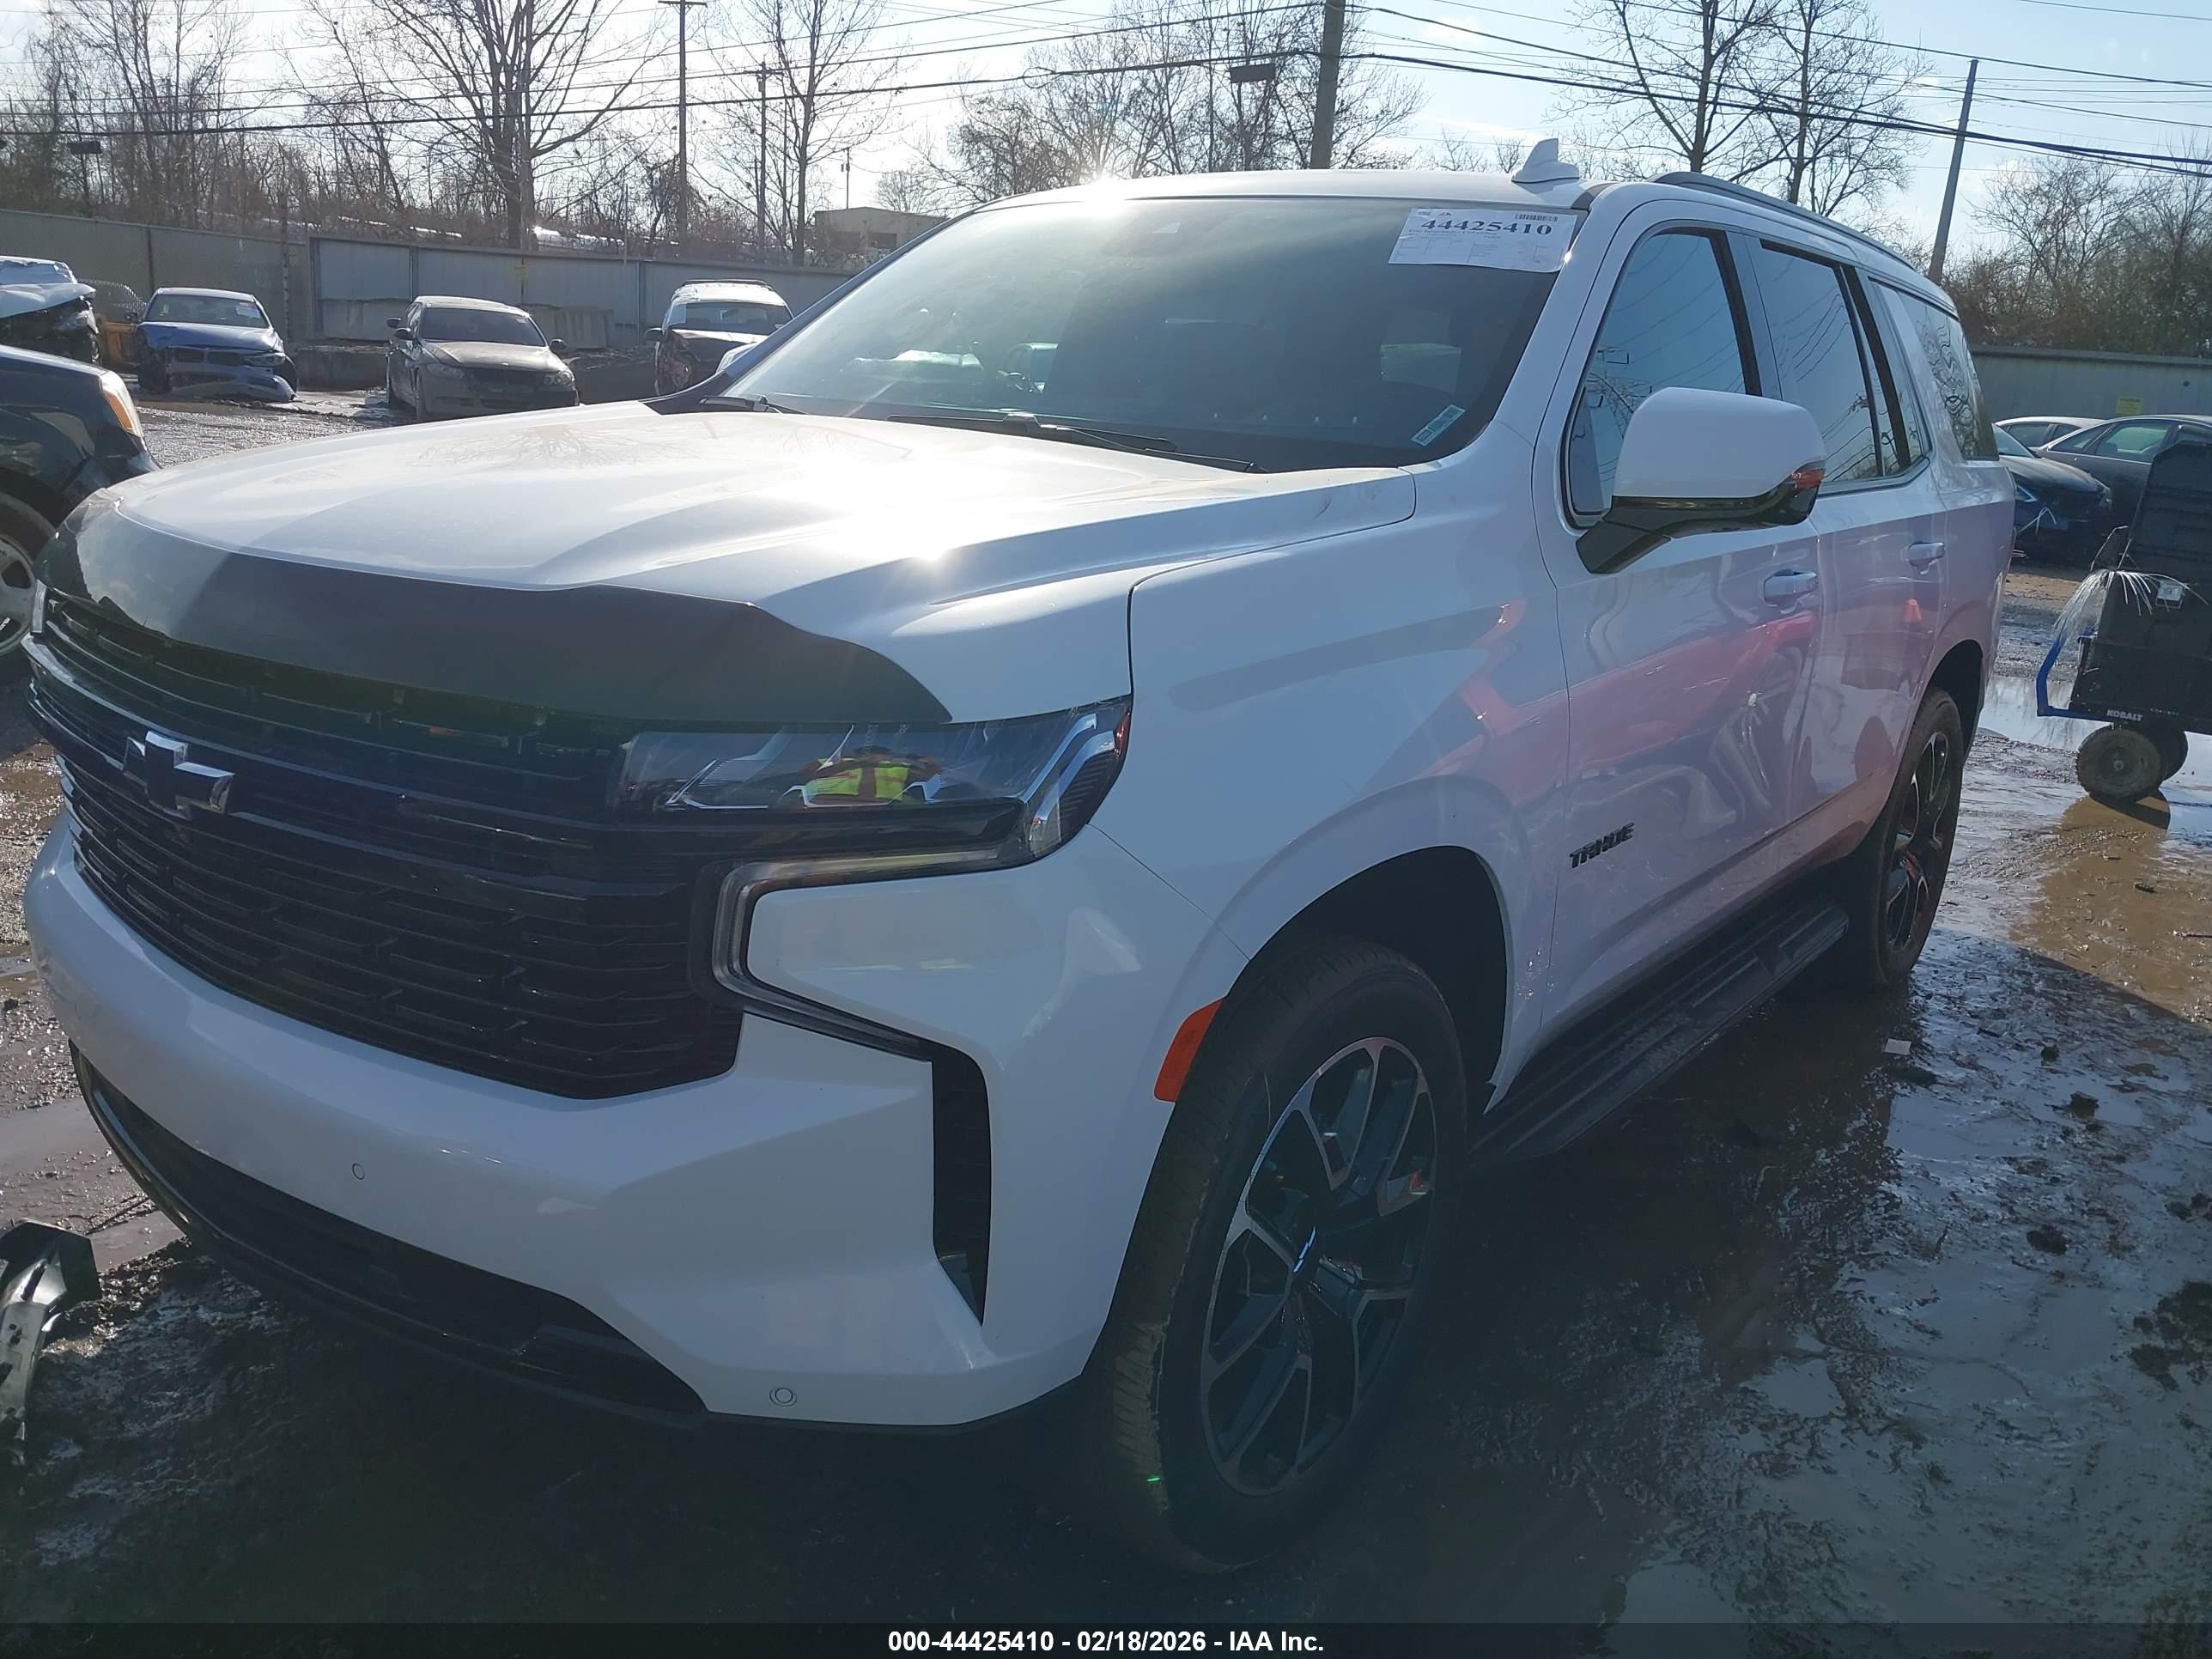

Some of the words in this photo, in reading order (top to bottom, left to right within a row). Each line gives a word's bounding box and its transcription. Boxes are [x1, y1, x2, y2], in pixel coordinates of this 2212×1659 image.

[1420, 219, 1553, 235] 44425410
[2106, 708, 2143, 722] KOBALT
[1569, 821, 1635, 870] TAHOE
